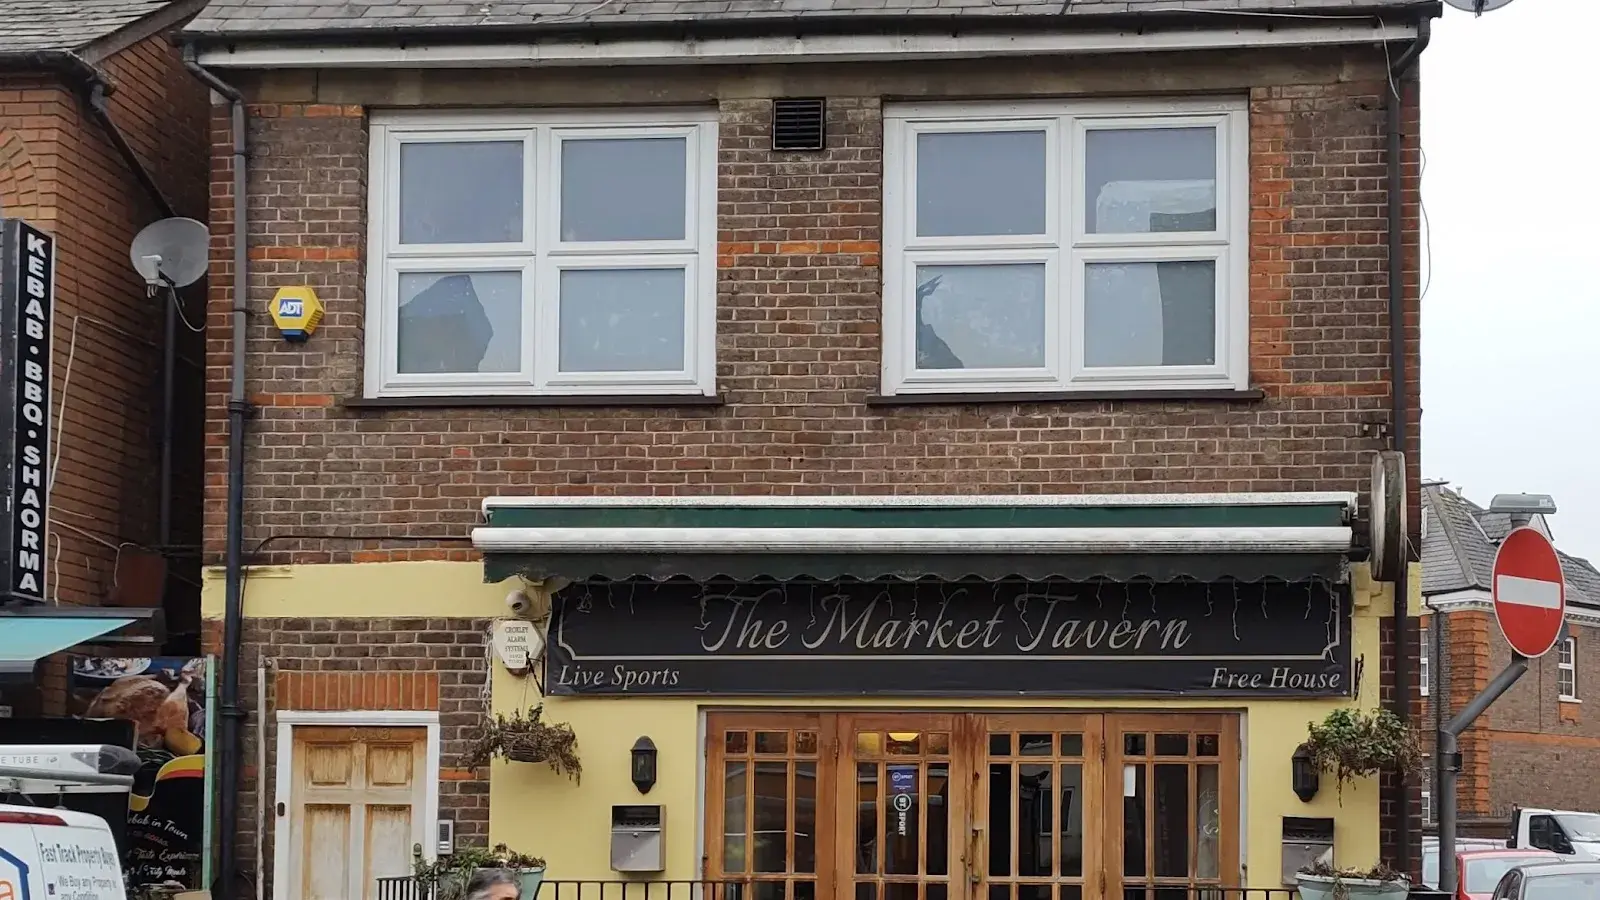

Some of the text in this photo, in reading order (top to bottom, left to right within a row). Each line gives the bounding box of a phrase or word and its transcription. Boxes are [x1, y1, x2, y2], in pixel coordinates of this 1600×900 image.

[279, 301, 303, 314] ADT
[20, 231, 46, 593] KEBAB BBQ SHAORMA
[702, 587, 1191, 652] The Market Tavern
[558, 664, 680, 691] Live Sports
[1211, 667, 1340, 688] Free House
[12, 756, 39, 764] TUBE
[151, 818, 161, 827] in
[164, 819, 188, 840] Town
[40, 843, 57, 863] Fast
